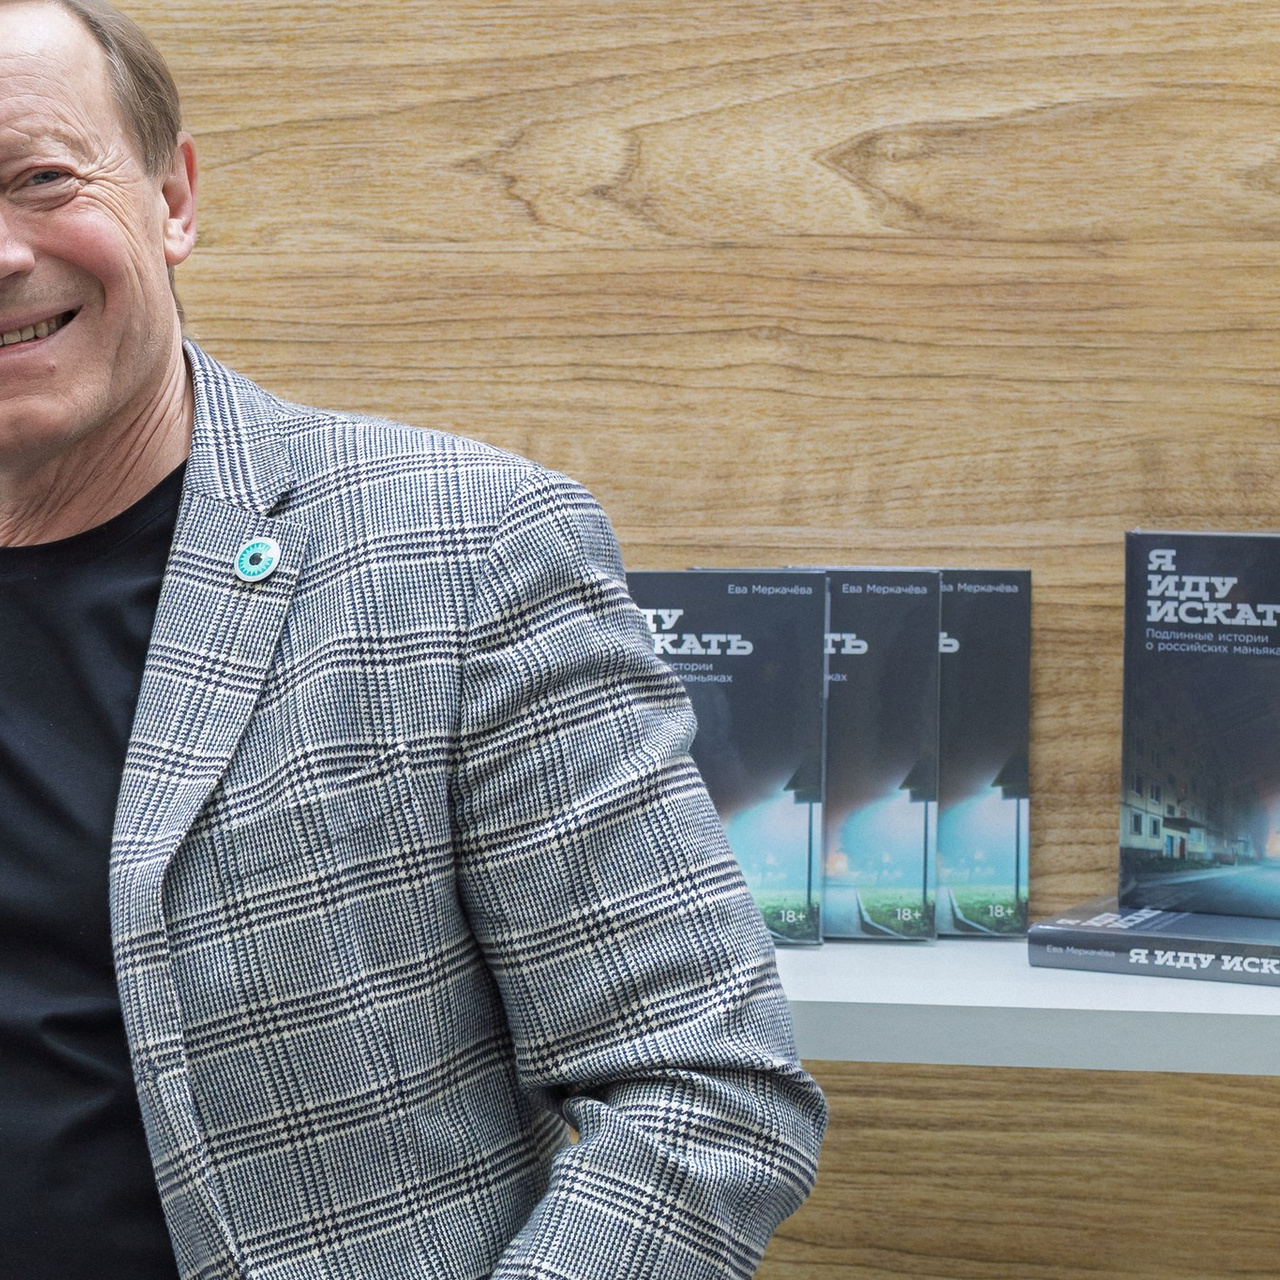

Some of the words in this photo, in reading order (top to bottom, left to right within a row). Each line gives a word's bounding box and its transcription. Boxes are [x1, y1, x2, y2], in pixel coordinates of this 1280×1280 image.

[1148, 549, 1176, 571] Я
[728, 584, 748, 594] Ева
[752, 584, 812, 596] Меркачёва
[842, 583, 862, 594] Ева
[866, 584, 927, 595] Меркачёва
[957, 583, 1019, 594] Меркачёва
[1147, 574, 1238, 601] ИДУ
[1146, 628, 1214, 641] Подлинные
[1219, 634, 1269, 645] истории
[651, 633, 755, 656] КАТЬ
[1146, 642, 1154, 650] о
[1158, 642, 1228, 653] российских
[669, 663, 713, 672] стории
[780, 910, 806, 922] 18+
[895, 908, 922, 921] 18+
[988, 905, 1014, 917] 18+
[1047, 945, 1063, 954] Ева
[1129, 948, 1149, 965] Я
[1154, 950, 1215, 970] ИДУ
